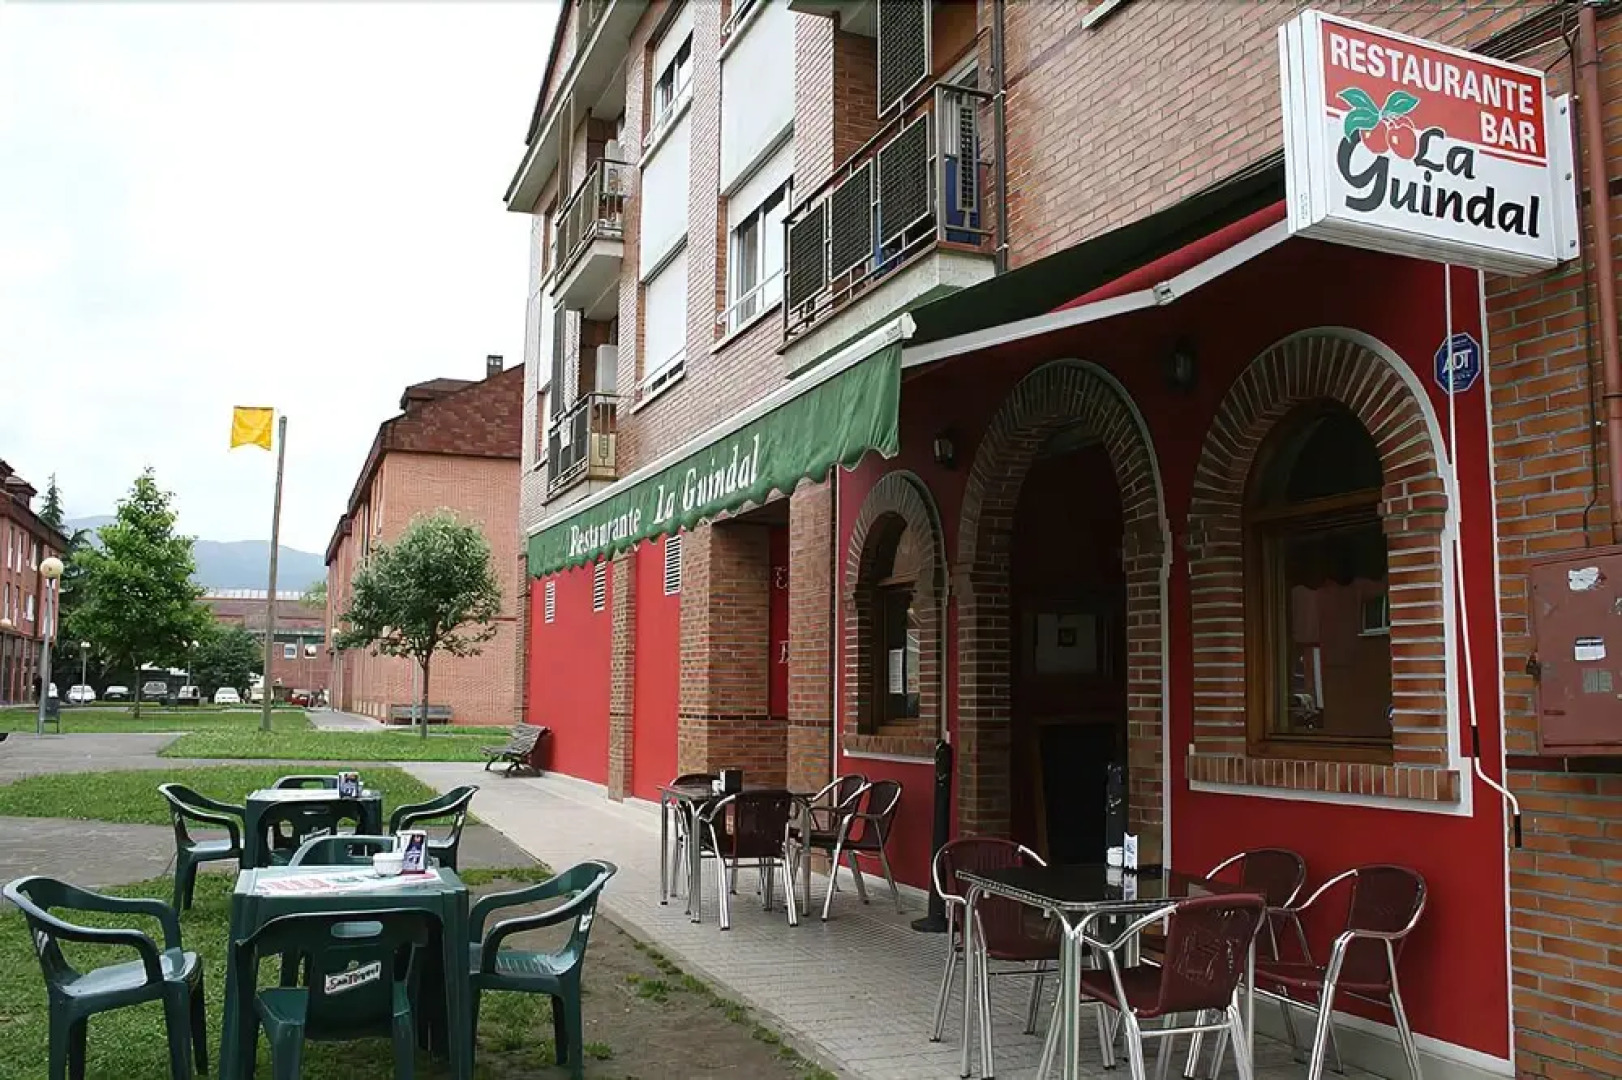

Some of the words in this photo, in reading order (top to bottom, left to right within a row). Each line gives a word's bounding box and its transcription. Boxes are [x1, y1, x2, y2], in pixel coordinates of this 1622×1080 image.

[1329, 32, 1535, 116] RESTAURANTE
[1414, 127, 1476, 180] La
[1480, 111, 1537, 153] BAR
[569, 507, 642, 557] Restaurante
[653, 484, 675, 525] La
[682, 433, 760, 512] Guindal
